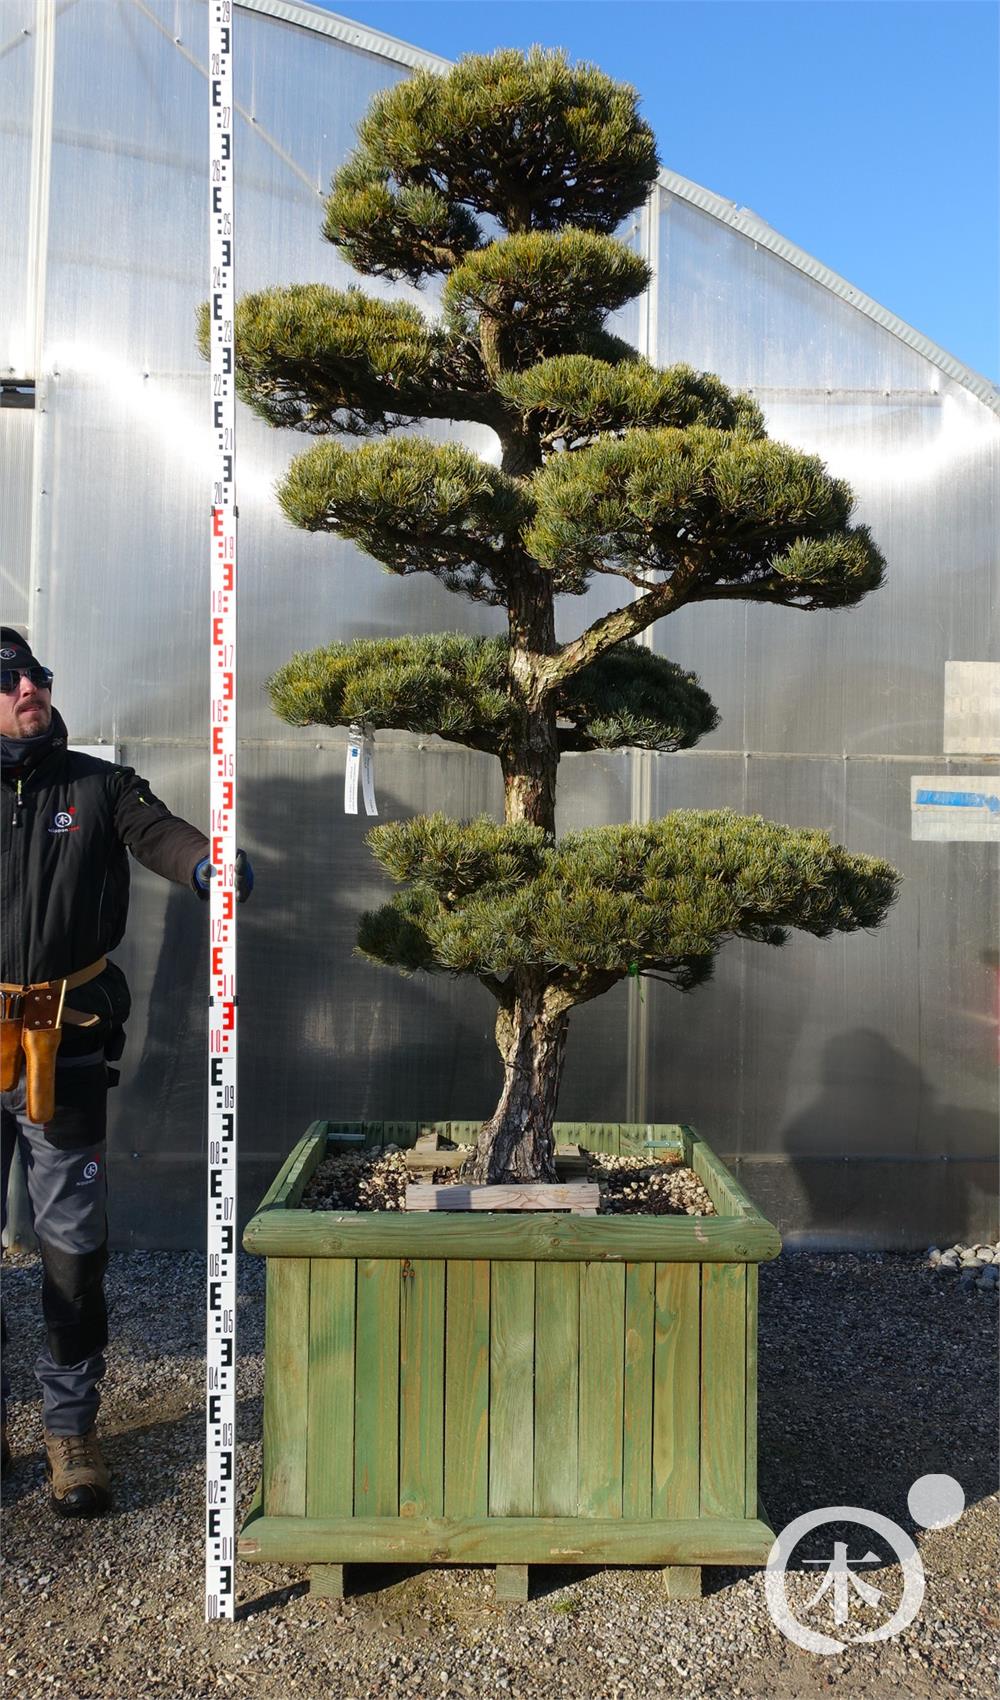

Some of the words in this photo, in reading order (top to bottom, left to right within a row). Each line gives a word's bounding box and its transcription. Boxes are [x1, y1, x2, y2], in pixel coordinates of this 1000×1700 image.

[223, 107, 230, 128] 27
[223, 213, 231, 235] 25
[213, 266, 220, 288] 24
[224, 320, 231, 342] 23
[213, 374, 221, 396] 22
[225, 428, 232, 450] 21
[214, 482, 222, 504] 20
[225, 645, 233, 667] 17
[212, 700, 221, 722] 16
[224, 754, 233, 776] 15
[212, 809, 221, 832] 14
[224, 864, 233, 887] 13
[212, 919, 221, 942] 12
[224, 974, 234, 997] 11
[211, 1029, 220, 1052] 10
[225, 1085, 234, 1108] 09
[210, 1141, 220, 1164] 08
[224, 1197, 233, 1220] 07
[209, 1254, 219, 1277] 06
[224, 1310, 233, 1333] 05
[209, 1367, 219, 1390] 04
[223, 1423, 232, 1446] 03
[208, 1480, 218, 1504] 02
[222, 1537, 232, 1560] 01
